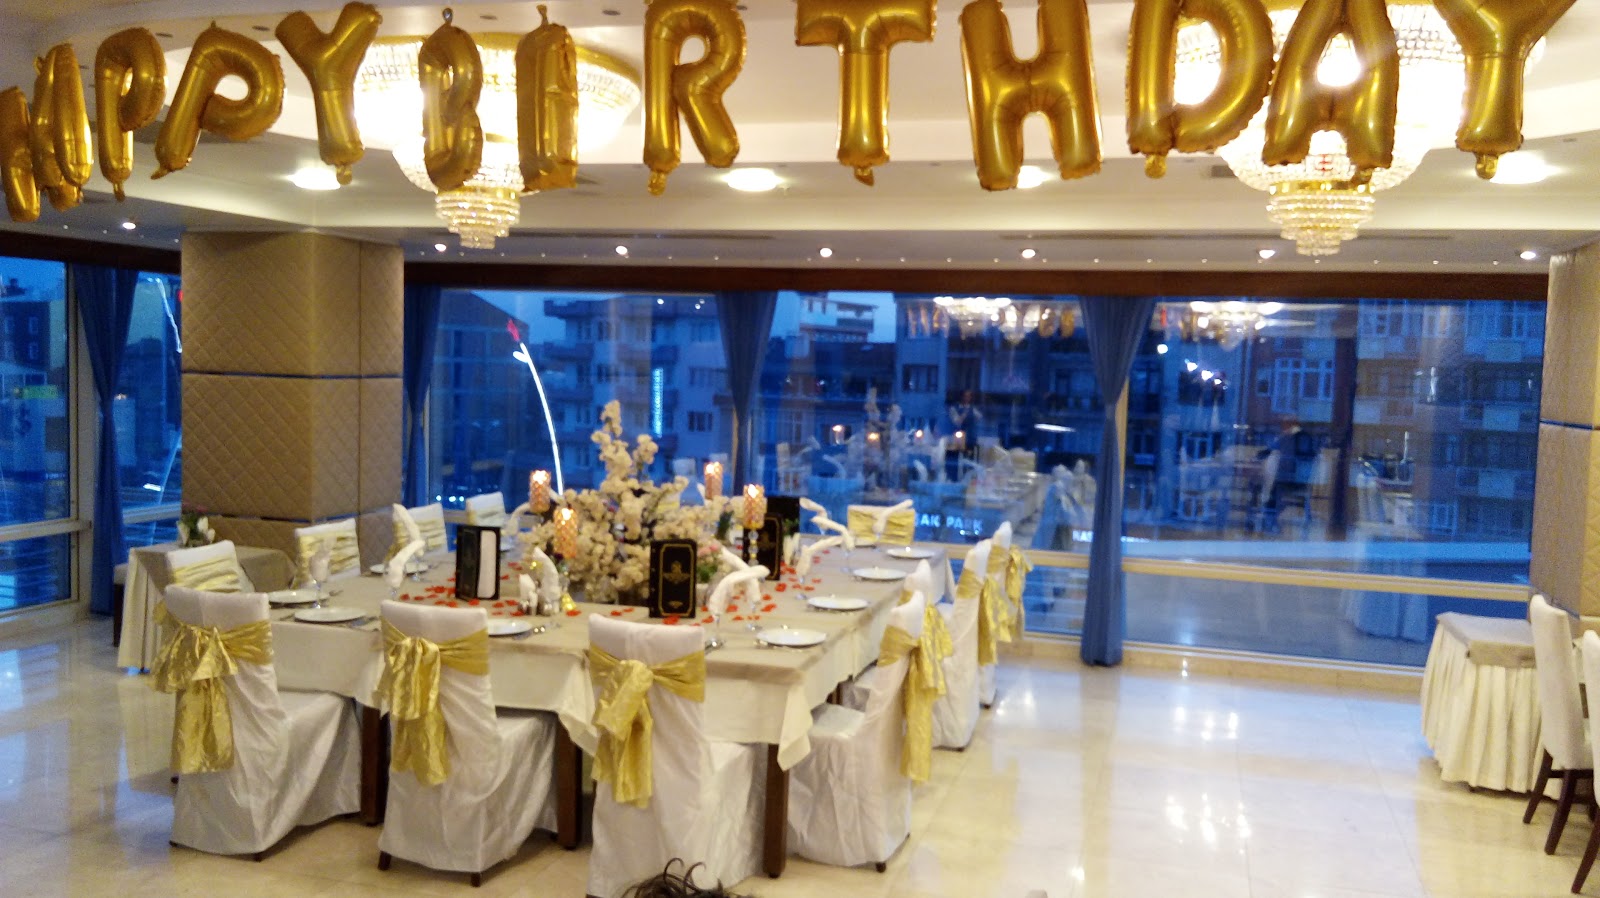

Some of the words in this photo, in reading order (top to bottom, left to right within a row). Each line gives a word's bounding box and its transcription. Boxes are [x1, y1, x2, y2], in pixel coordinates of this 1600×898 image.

[422, 0, 1578, 191] BIRTHDAY
[914, 512, 941, 528] AK
[946, 515, 983, 531] PARK
